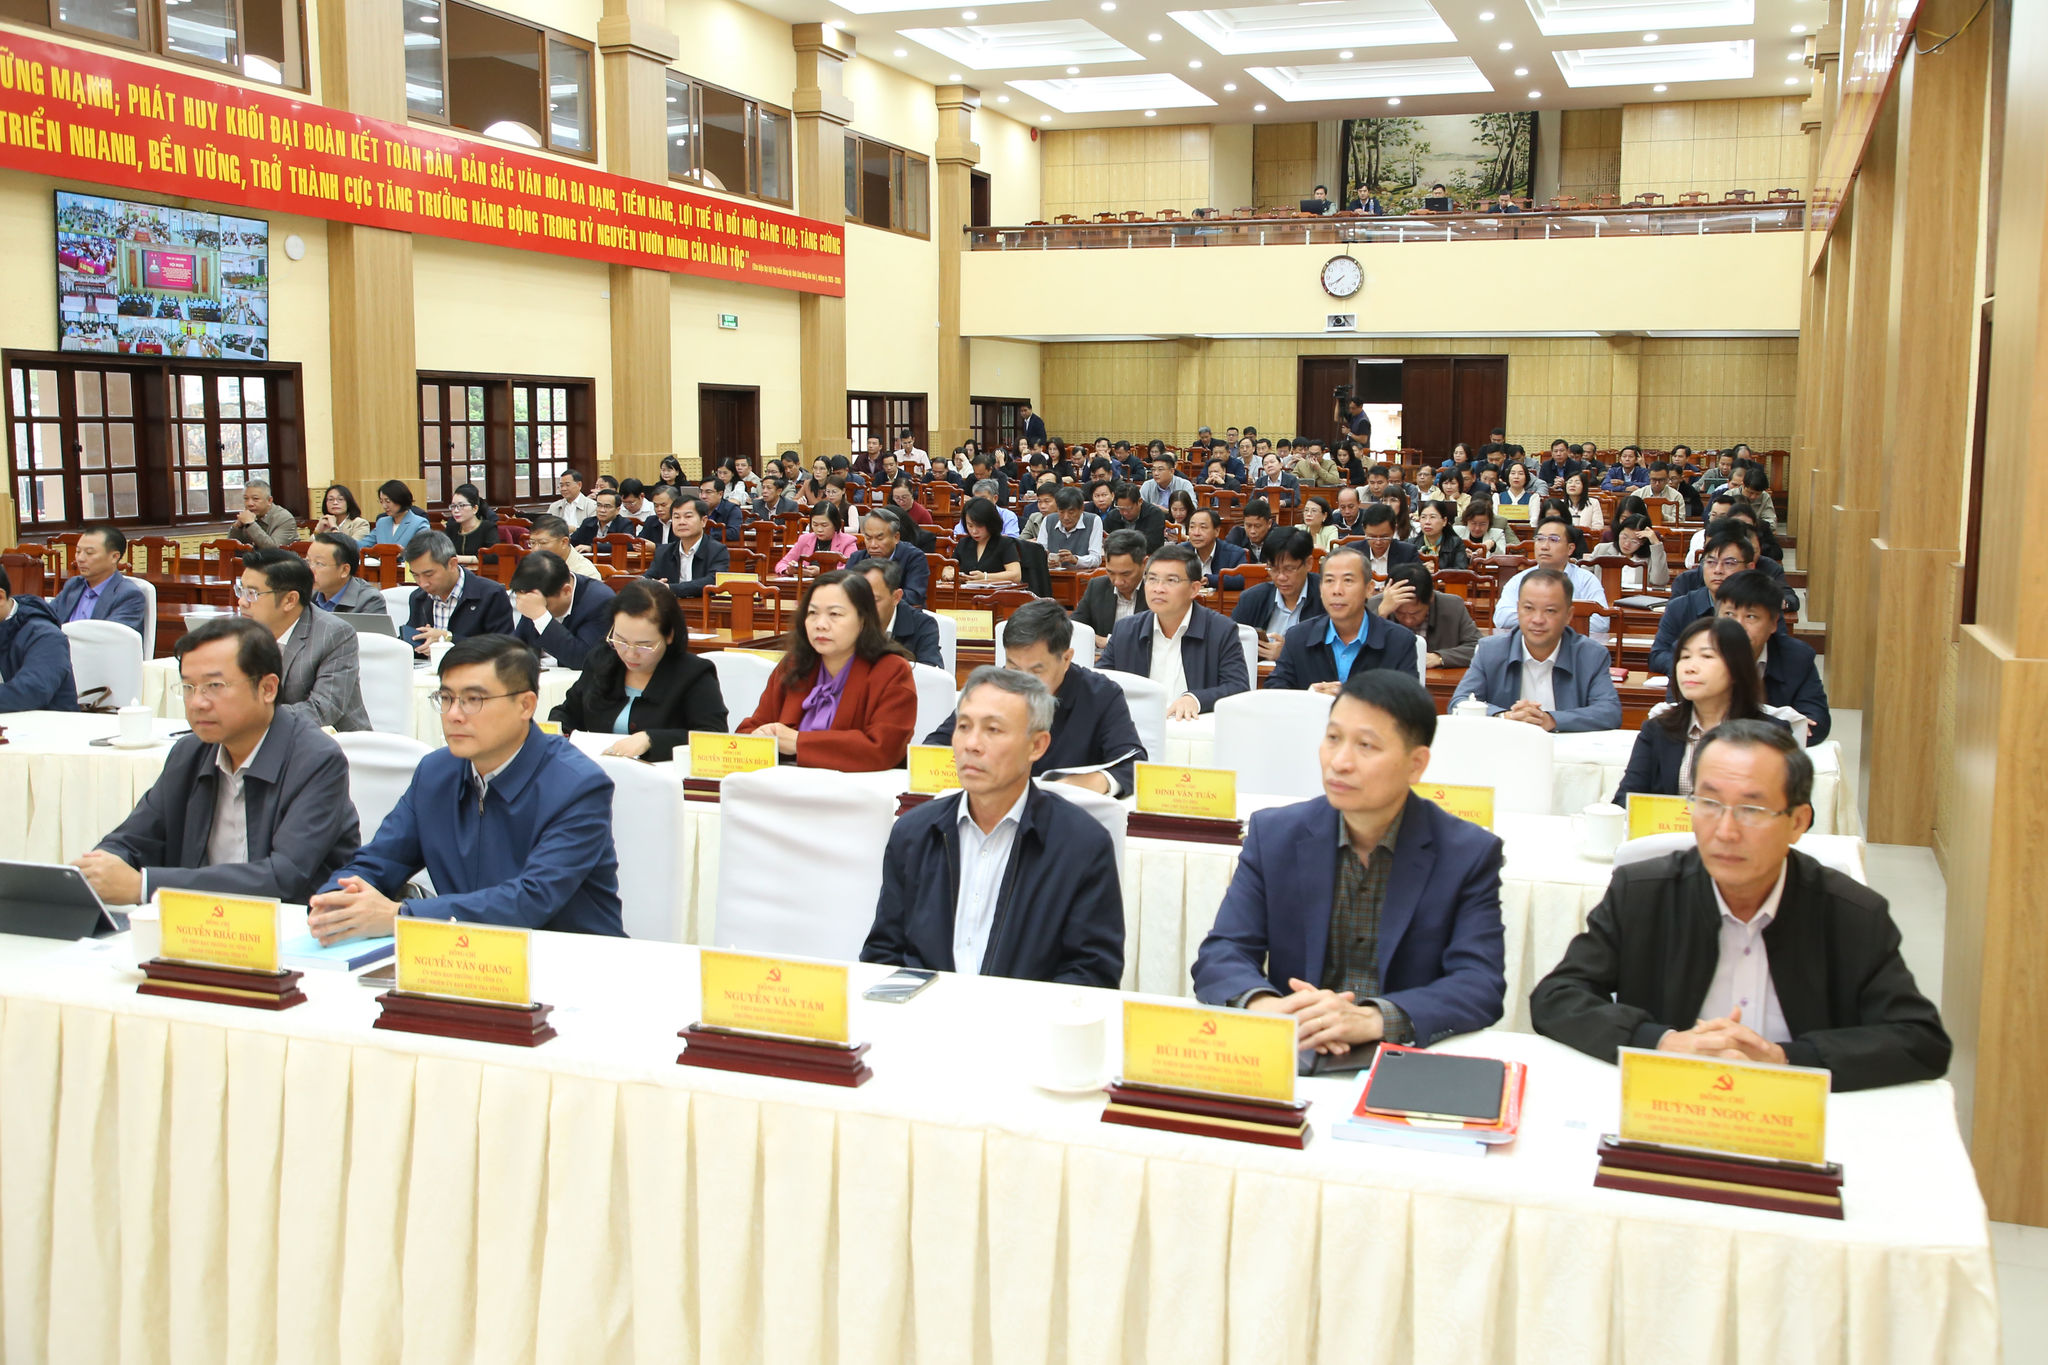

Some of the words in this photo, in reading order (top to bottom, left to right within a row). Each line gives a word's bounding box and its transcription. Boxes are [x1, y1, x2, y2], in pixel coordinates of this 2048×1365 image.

[51, 66, 121, 117] MẠNH;
[127, 83, 176, 123] PHÁT
[183, 96, 218, 131] HUY
[225, 103, 265, 141] KHỐI
[269, 115, 299, 151] ĐẠI
[303, 121, 346, 157] ĐOÀN
[350, 129, 379, 164] KẾT
[384, 139, 422, 173] TOÀN
[461, 152, 487, 186] BẢN
[490, 157, 514, 191] SẮC
[517, 167, 542, 197] VĂN
[545, 172, 568, 202] HÓA
[570, 181, 586, 206] ĐA
[589, 184, 619, 217] DẠNG,
[621, 187, 646, 217] TIỀM
[648, 195, 677, 227] NĂNG,
[678, 203, 693, 229] LỢI
[695, 204, 712, 231] THẾ
[713, 209, 724, 233] VÀ
[726, 208, 740, 236] ĐỔI
[759, 219, 780, 244] SÁNG
[781, 226, 799, 250] TẠO;
[800, 227, 818, 251] TĂNG
[819, 230, 841, 256] CƯỜNG
[69, 123, 143, 173] NHANH,
[148, 133, 187, 175] BỀN
[193, 143, 247, 191] VỮNG,
[250, 153, 282, 192] TRỞ
[288, 164, 339, 201] THÀNH
[344, 175, 373, 210] CỰC
[376, 179, 413, 214] TĂNG
[417, 187, 468, 223] TRƯỞNG
[471, 197, 504, 229] NĂNG
[507, 203, 539, 236] ĐỘNG
[542, 213, 577, 241] TRONG
[579, 215, 594, 244] KỶ
[597, 224, 637, 251] NGUYÊN
[639, 230, 664, 256] VƯƠN
[666, 234, 689, 260] MÌNH
[691, 235, 709, 263] CỦA
[710, 241, 728, 266] DÂN
[176, 924, 211, 937] NGUYỄN
[213, 928, 237, 940] KHẮC
[414, 954, 453, 968] NGUYỄN
[455, 959, 476, 971] VĂN
[478, 963, 512, 976] QUANG
[724, 989, 770, 1004] NGUYỄN
[773, 995, 797, 1007] VĂN
[1183, 1047, 1209, 1060] HUY
[1652, 1098, 1706, 1117] HUỲNH
